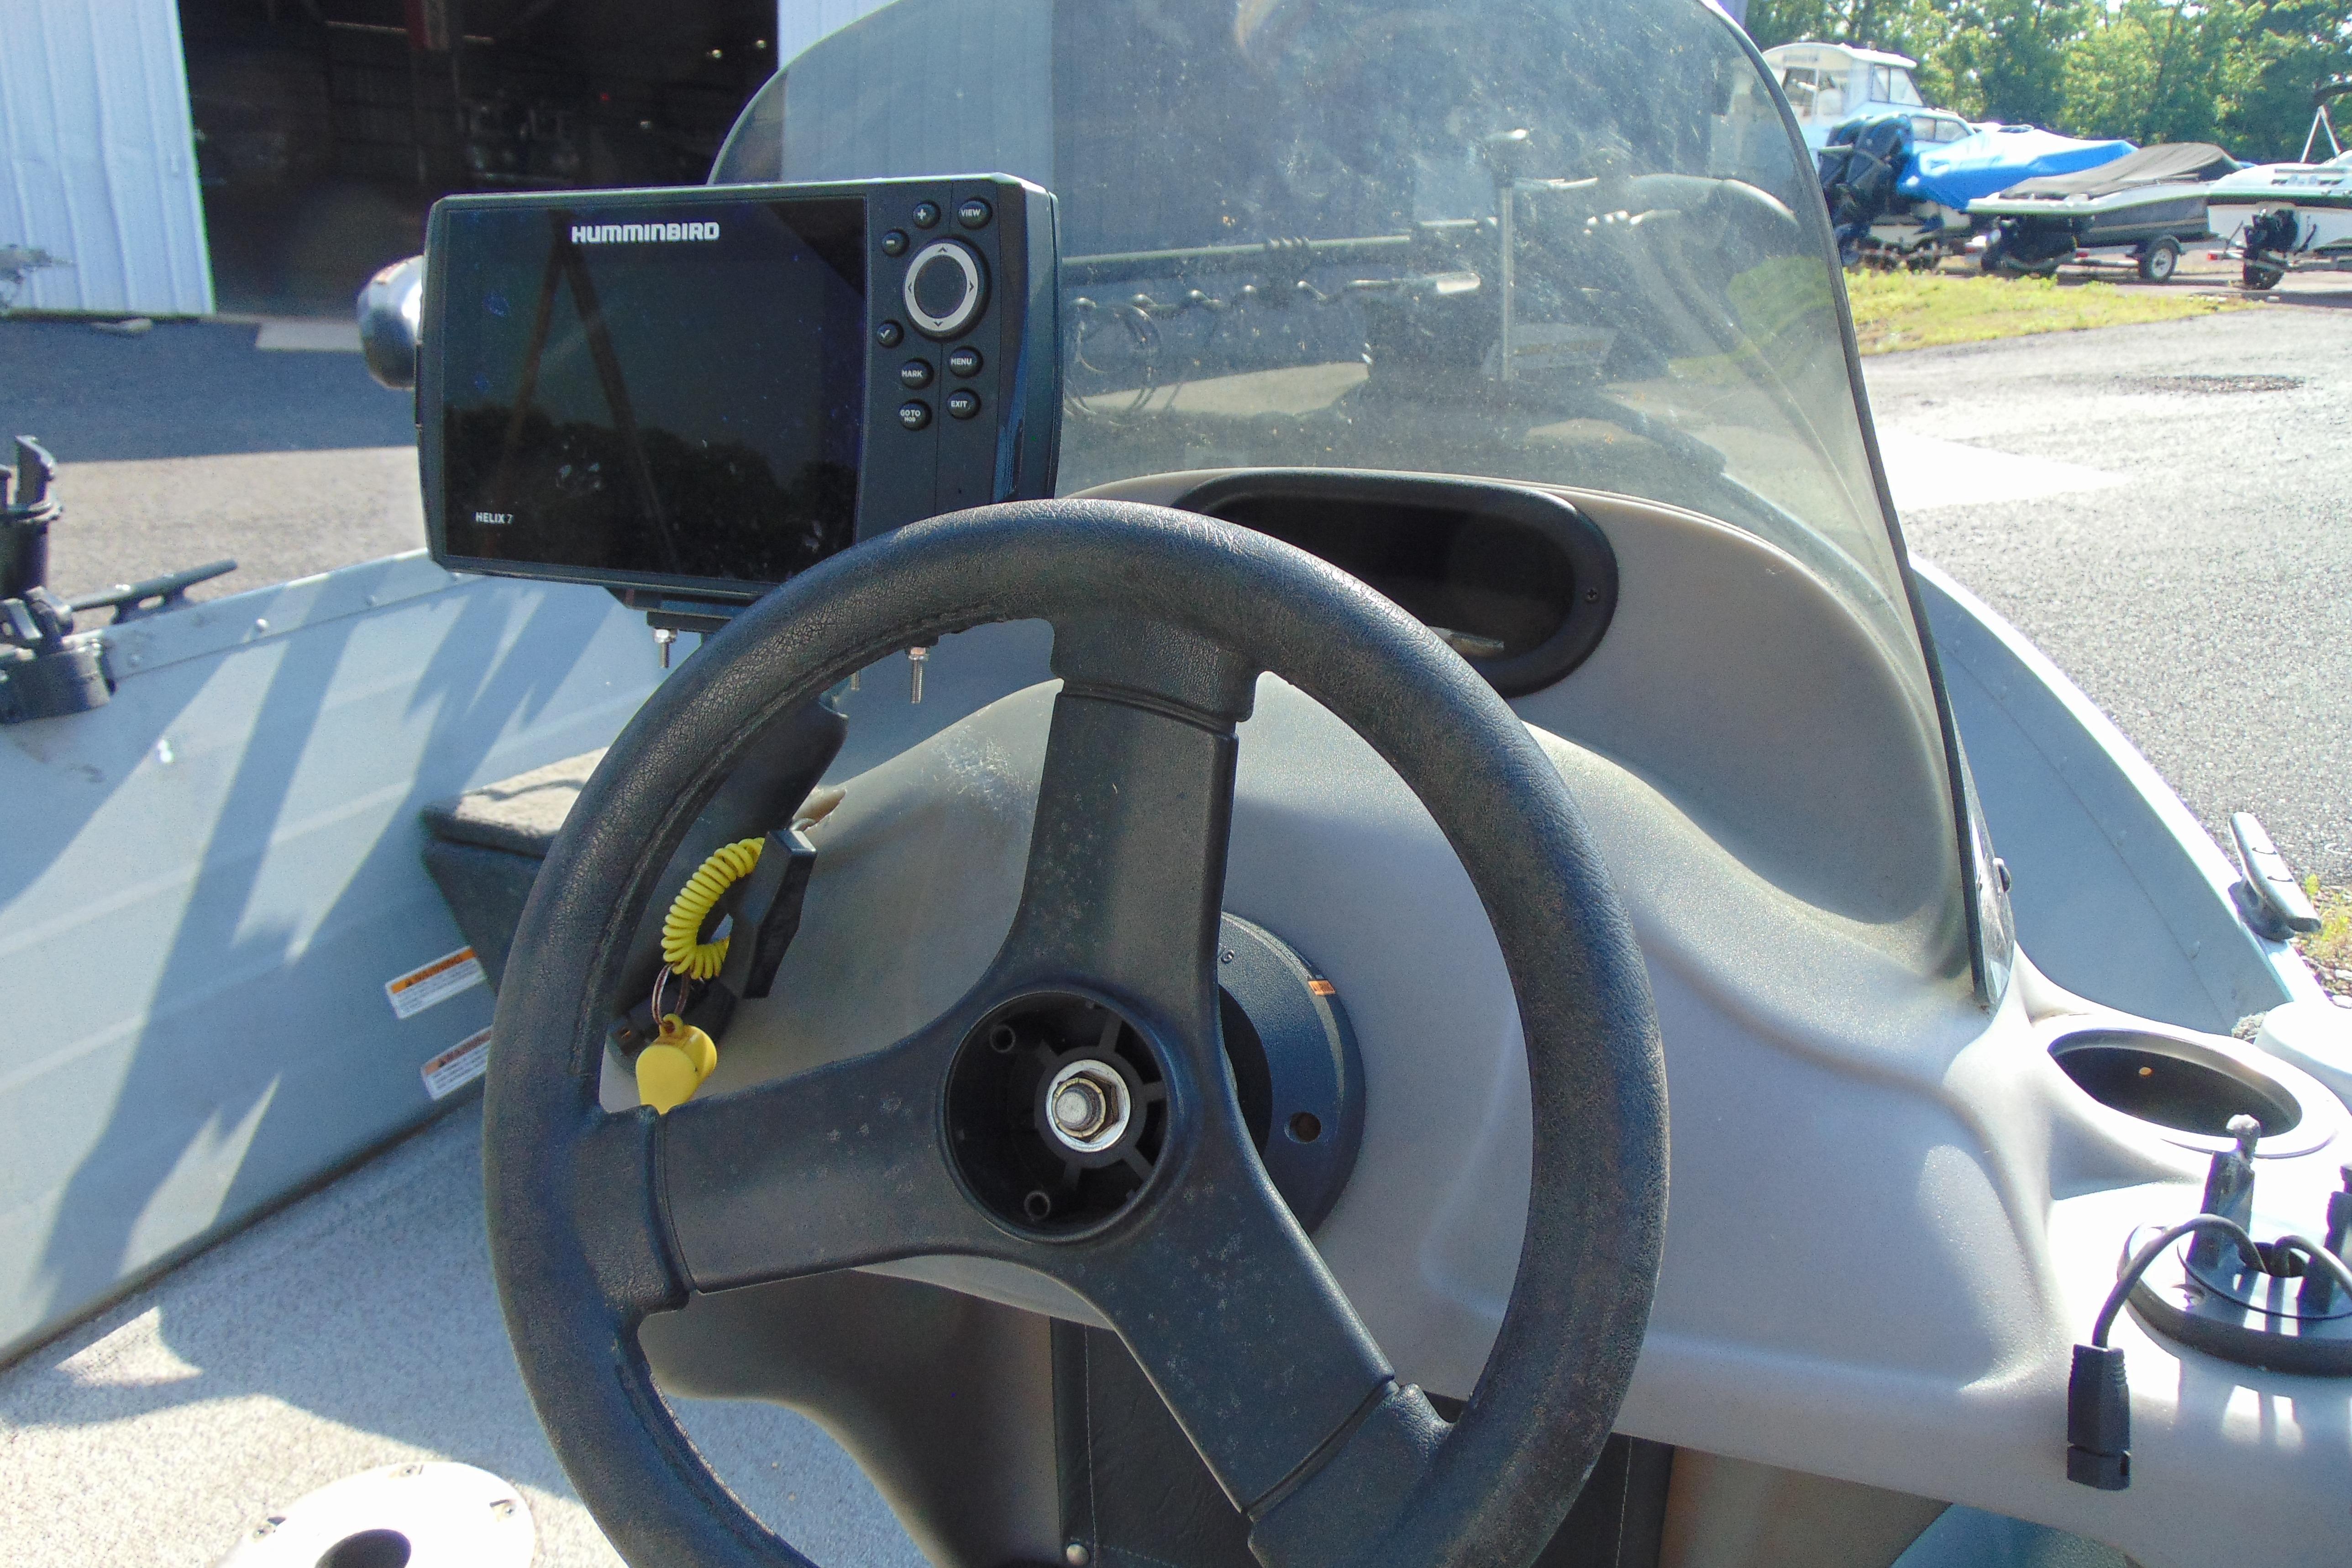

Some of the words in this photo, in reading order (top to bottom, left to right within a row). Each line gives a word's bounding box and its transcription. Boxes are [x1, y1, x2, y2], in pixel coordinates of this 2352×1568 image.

[961, 209, 981, 217] VIEW
[572, 222, 720, 243] HUMMINBIRD
[476, 512, 504, 524] HELIX
[507, 514, 513, 524] 7
